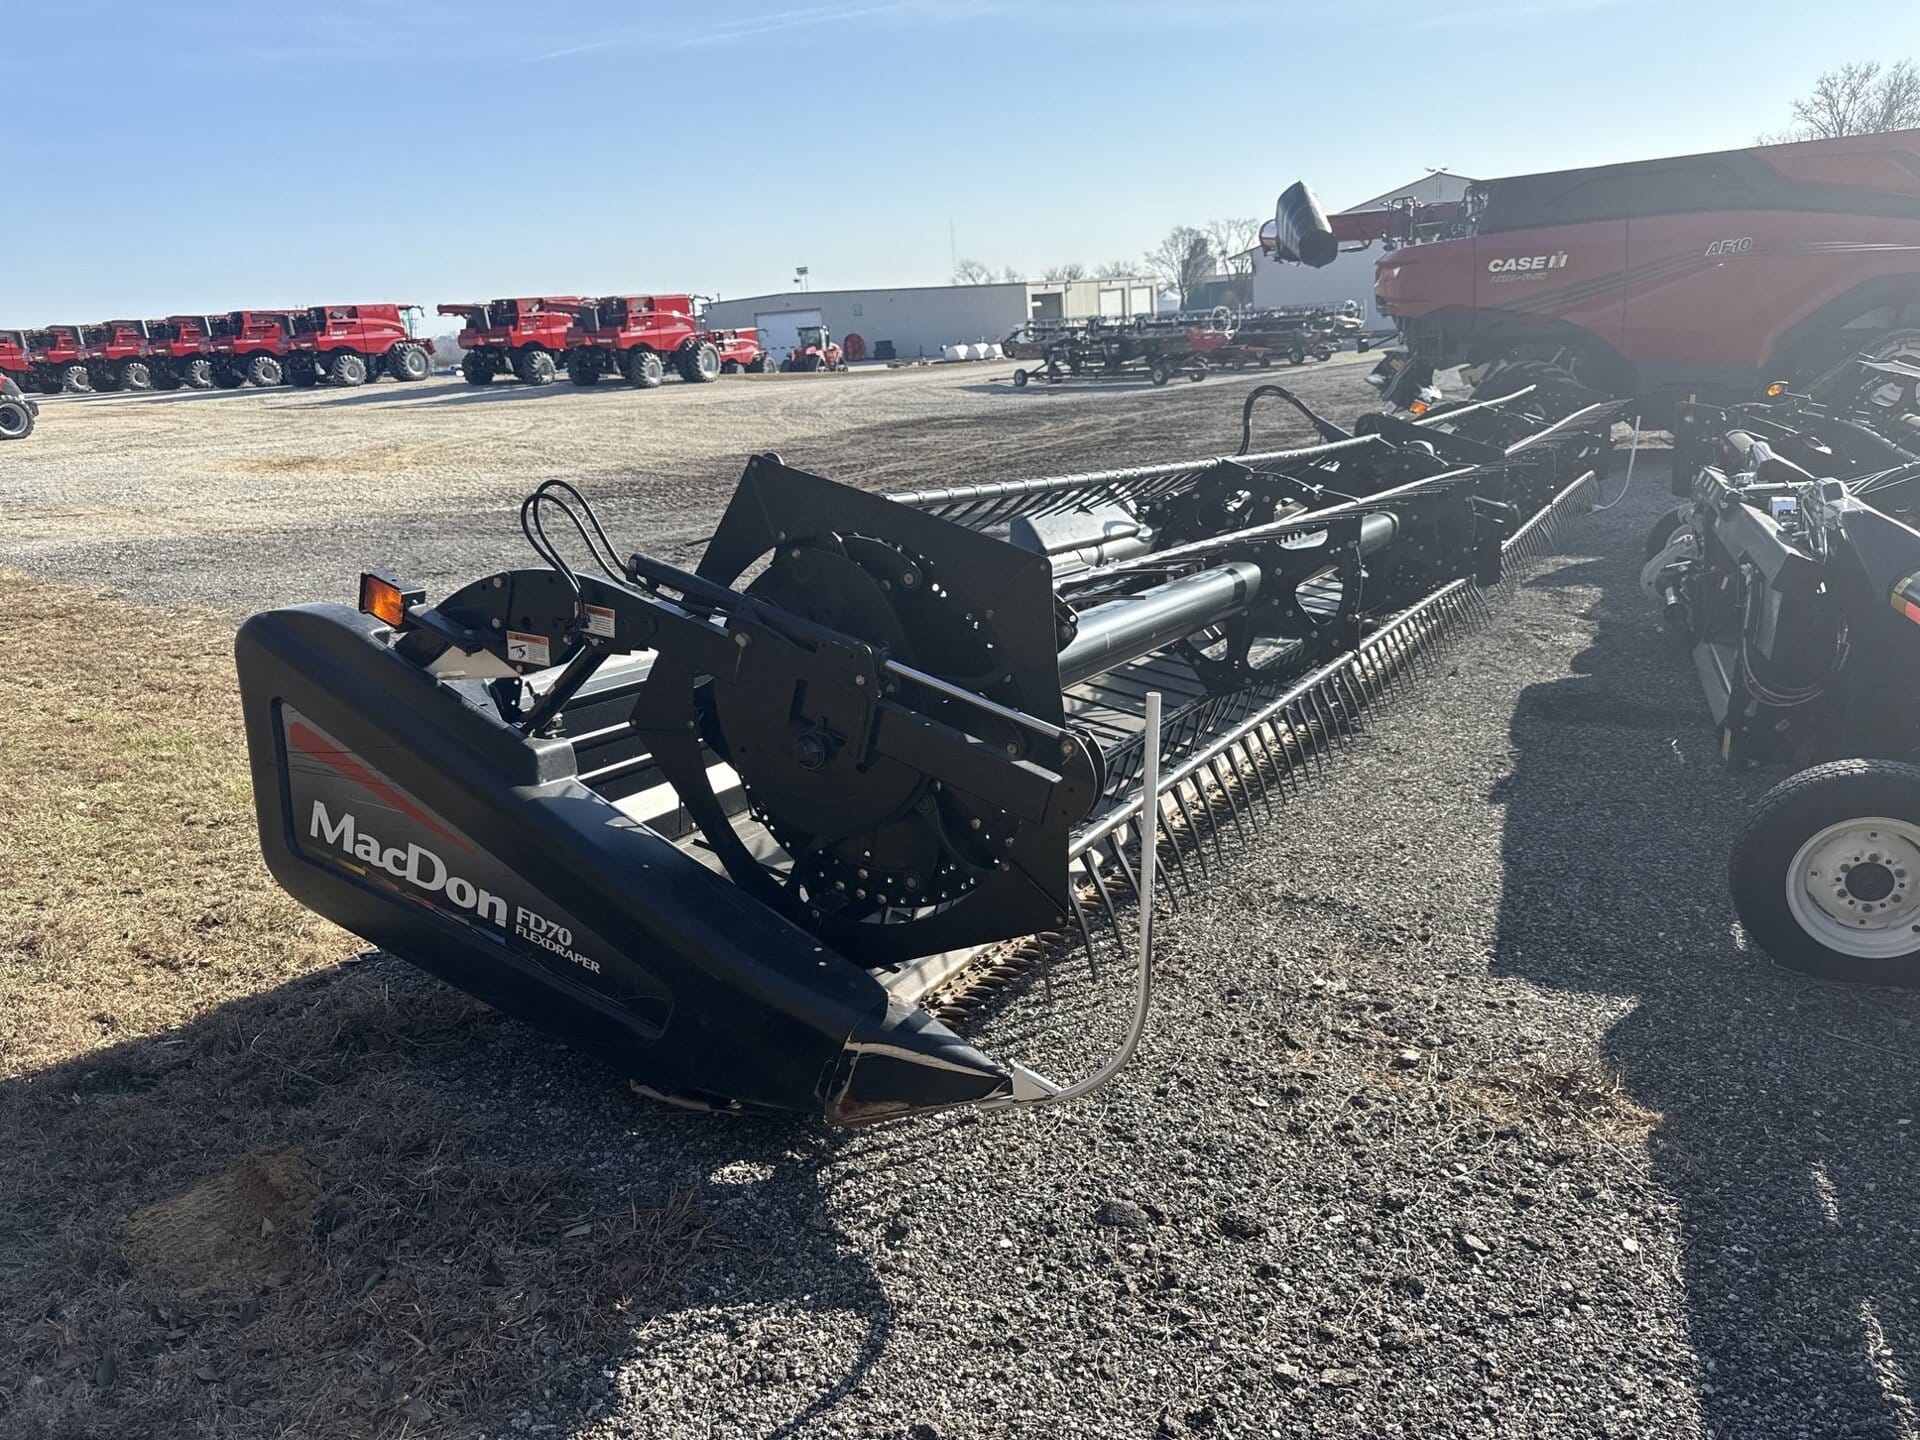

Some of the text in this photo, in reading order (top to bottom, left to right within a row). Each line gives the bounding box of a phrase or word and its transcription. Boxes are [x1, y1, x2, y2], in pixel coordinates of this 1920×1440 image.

[1488, 249, 1569, 273] CASE IH
[1704, 237, 1753, 256] AF10
[310, 799, 508, 928] MacDon
[516, 905, 573, 946] FD70
[515, 924, 601, 974] FLEXDRAPER
